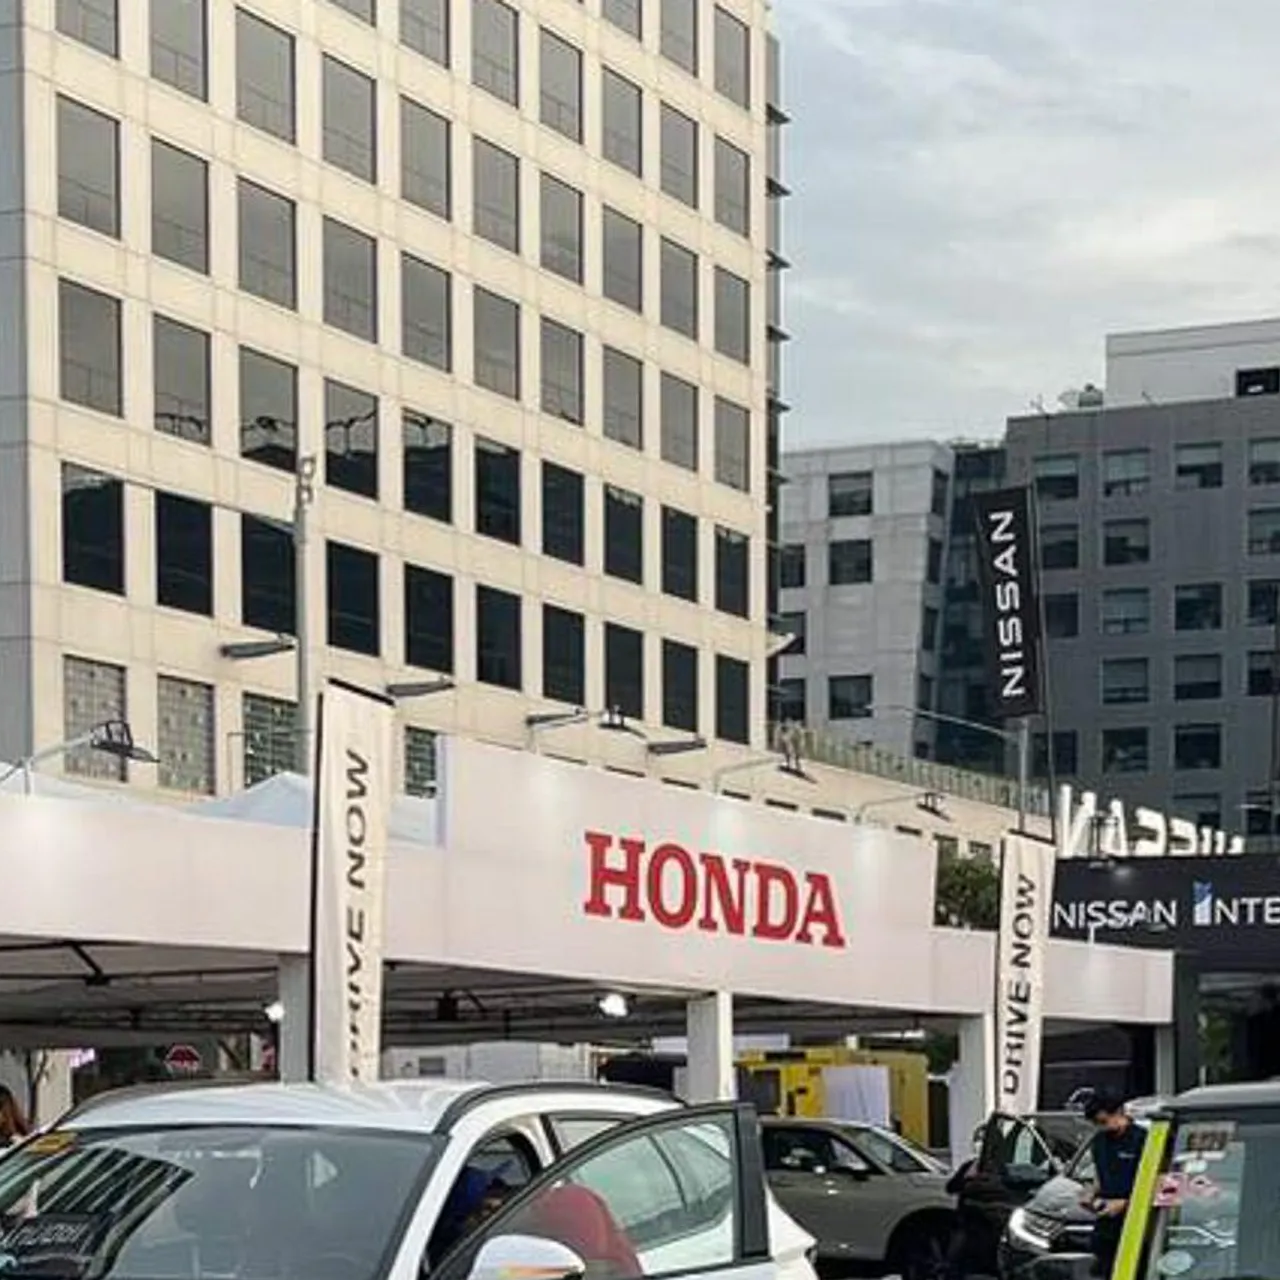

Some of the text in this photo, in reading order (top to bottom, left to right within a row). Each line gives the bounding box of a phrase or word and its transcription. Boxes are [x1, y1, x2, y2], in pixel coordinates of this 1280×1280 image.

[988, 511, 1026, 697] NISSAN
[346, 749, 369, 890] NOW
[583, 831, 846, 948] HONDA
[1003, 873, 1036, 1095] DRIVE NOW
[1053, 900, 1177, 930] NISSAN
